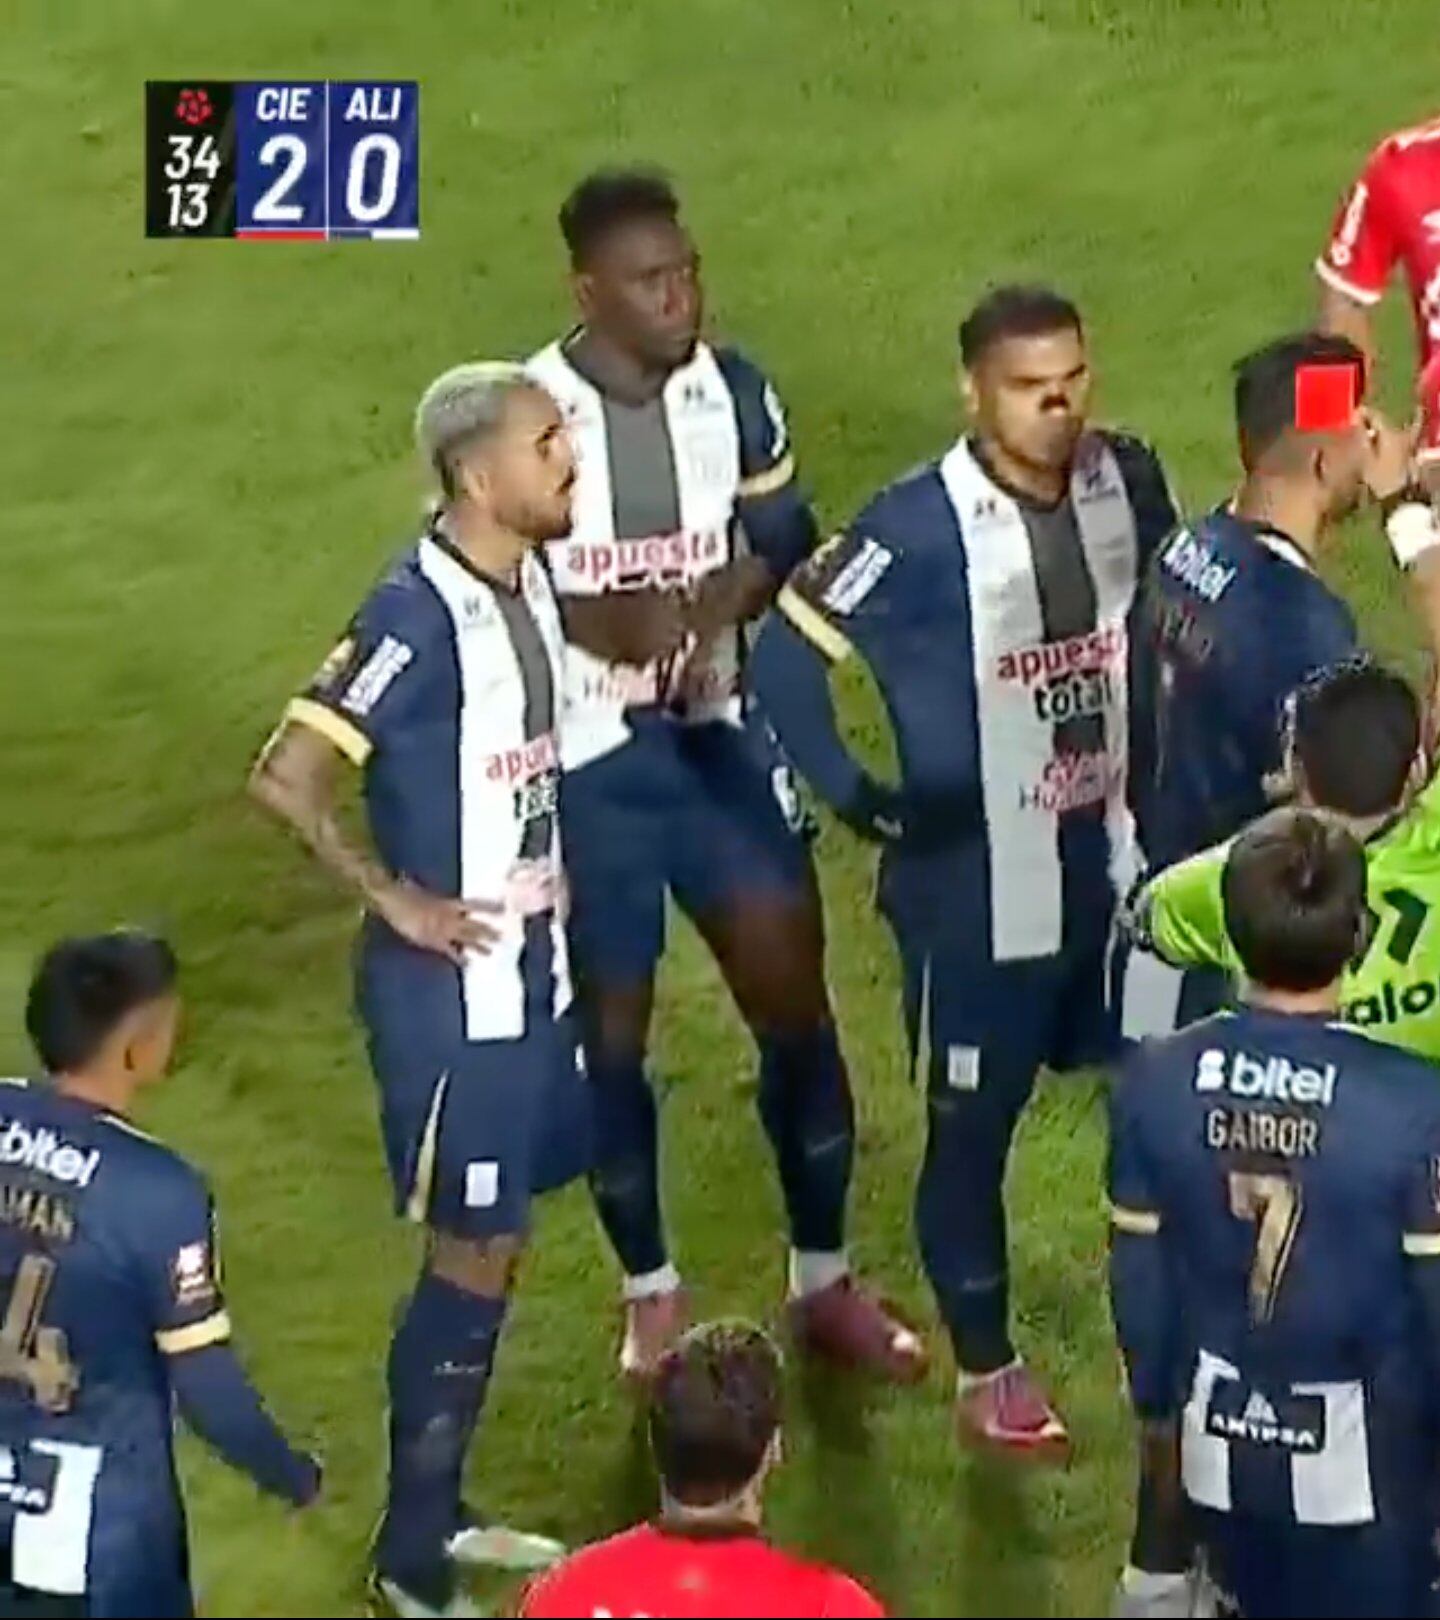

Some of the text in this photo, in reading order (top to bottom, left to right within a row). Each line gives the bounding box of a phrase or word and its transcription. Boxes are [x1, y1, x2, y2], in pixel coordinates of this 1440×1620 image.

[567, 531, 717, 583] apuesta
[1034, 670, 1112, 730] total
[1230, 1053, 1336, 1105] bitel
[0, 1120, 100, 1188] bitel
[1207, 1109, 1318, 1157] GAIBOR
[1228, 1171, 1303, 1323] 7
